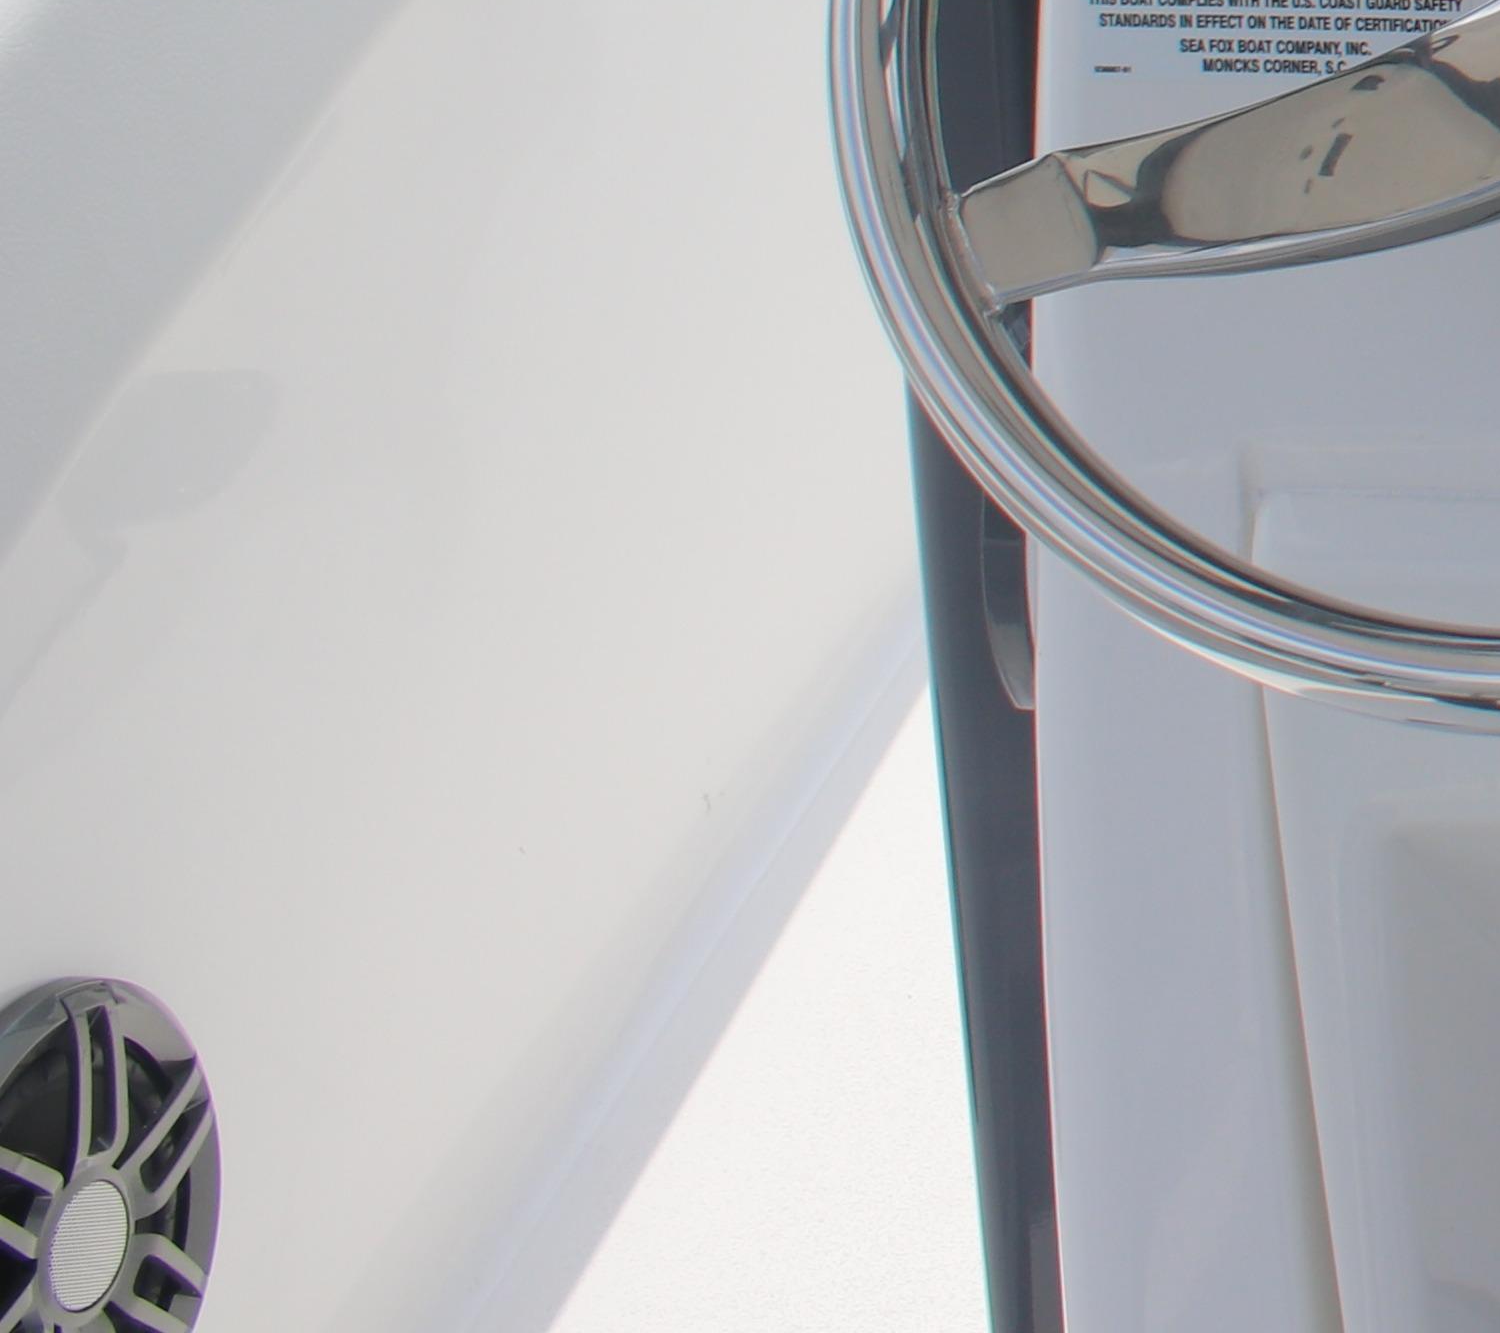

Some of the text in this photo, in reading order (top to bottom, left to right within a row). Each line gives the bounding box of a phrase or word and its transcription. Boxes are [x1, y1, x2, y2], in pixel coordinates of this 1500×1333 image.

[1099, 12, 1177, 29] STANDARDS
[1179, 14, 1193, 29] IN
[1195, 14, 1244, 30] EFFECT
[1246, 14, 1267, 30] ON
[1269, 15, 1295, 30] THE
[1297, 15, 1332, 31] DATE
[1333, 16, 1352, 31] OF
[1179, 38, 1373, 57] SEA FOX BOAT COMPANY, INC.
[1202, 57, 1261, 73] MONCKS
[1263, 58, 1322, 76] CORNER,
